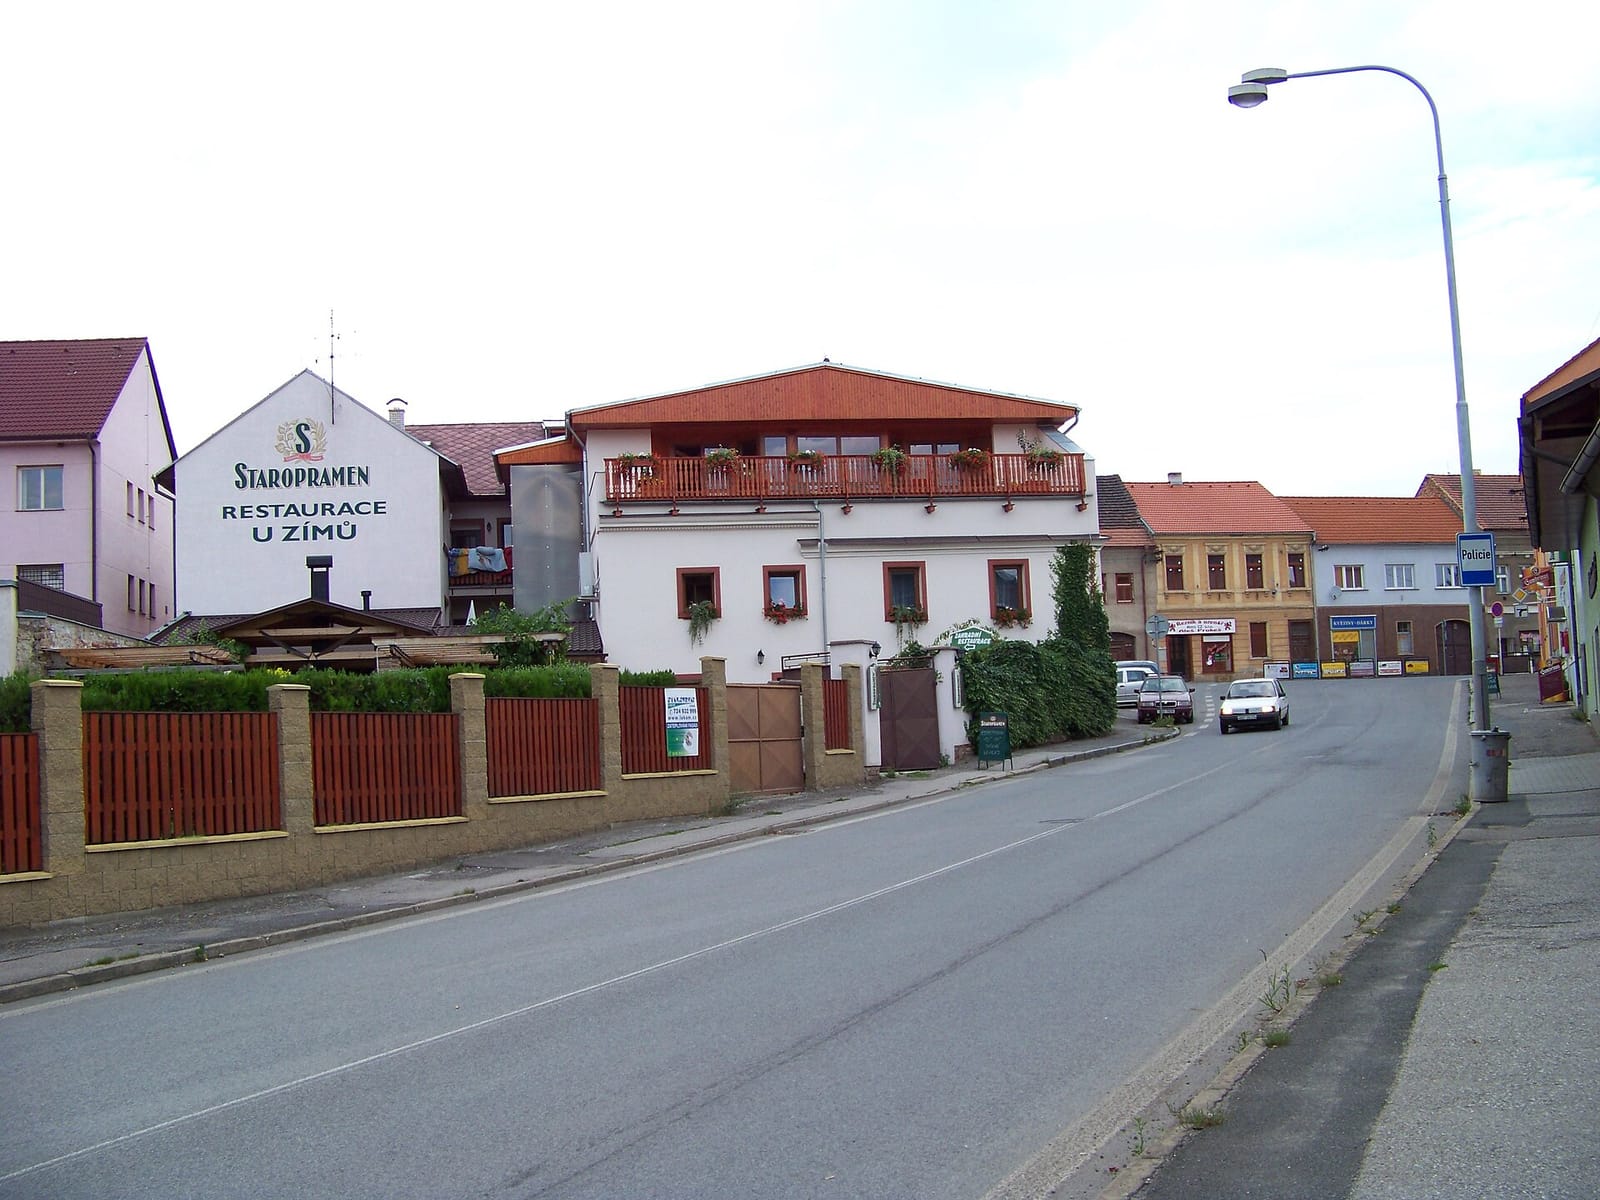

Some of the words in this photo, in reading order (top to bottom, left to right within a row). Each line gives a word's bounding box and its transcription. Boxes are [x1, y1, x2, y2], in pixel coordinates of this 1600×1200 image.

[295, 422, 311, 454] S
[234, 462, 370, 489] STAROPRAMEN
[222, 501, 387, 519] RESTAURACE
[252, 526, 273, 543] U
[281, 521, 357, 542] ZÍMŮ
[1461, 549, 1491, 560] Policie
